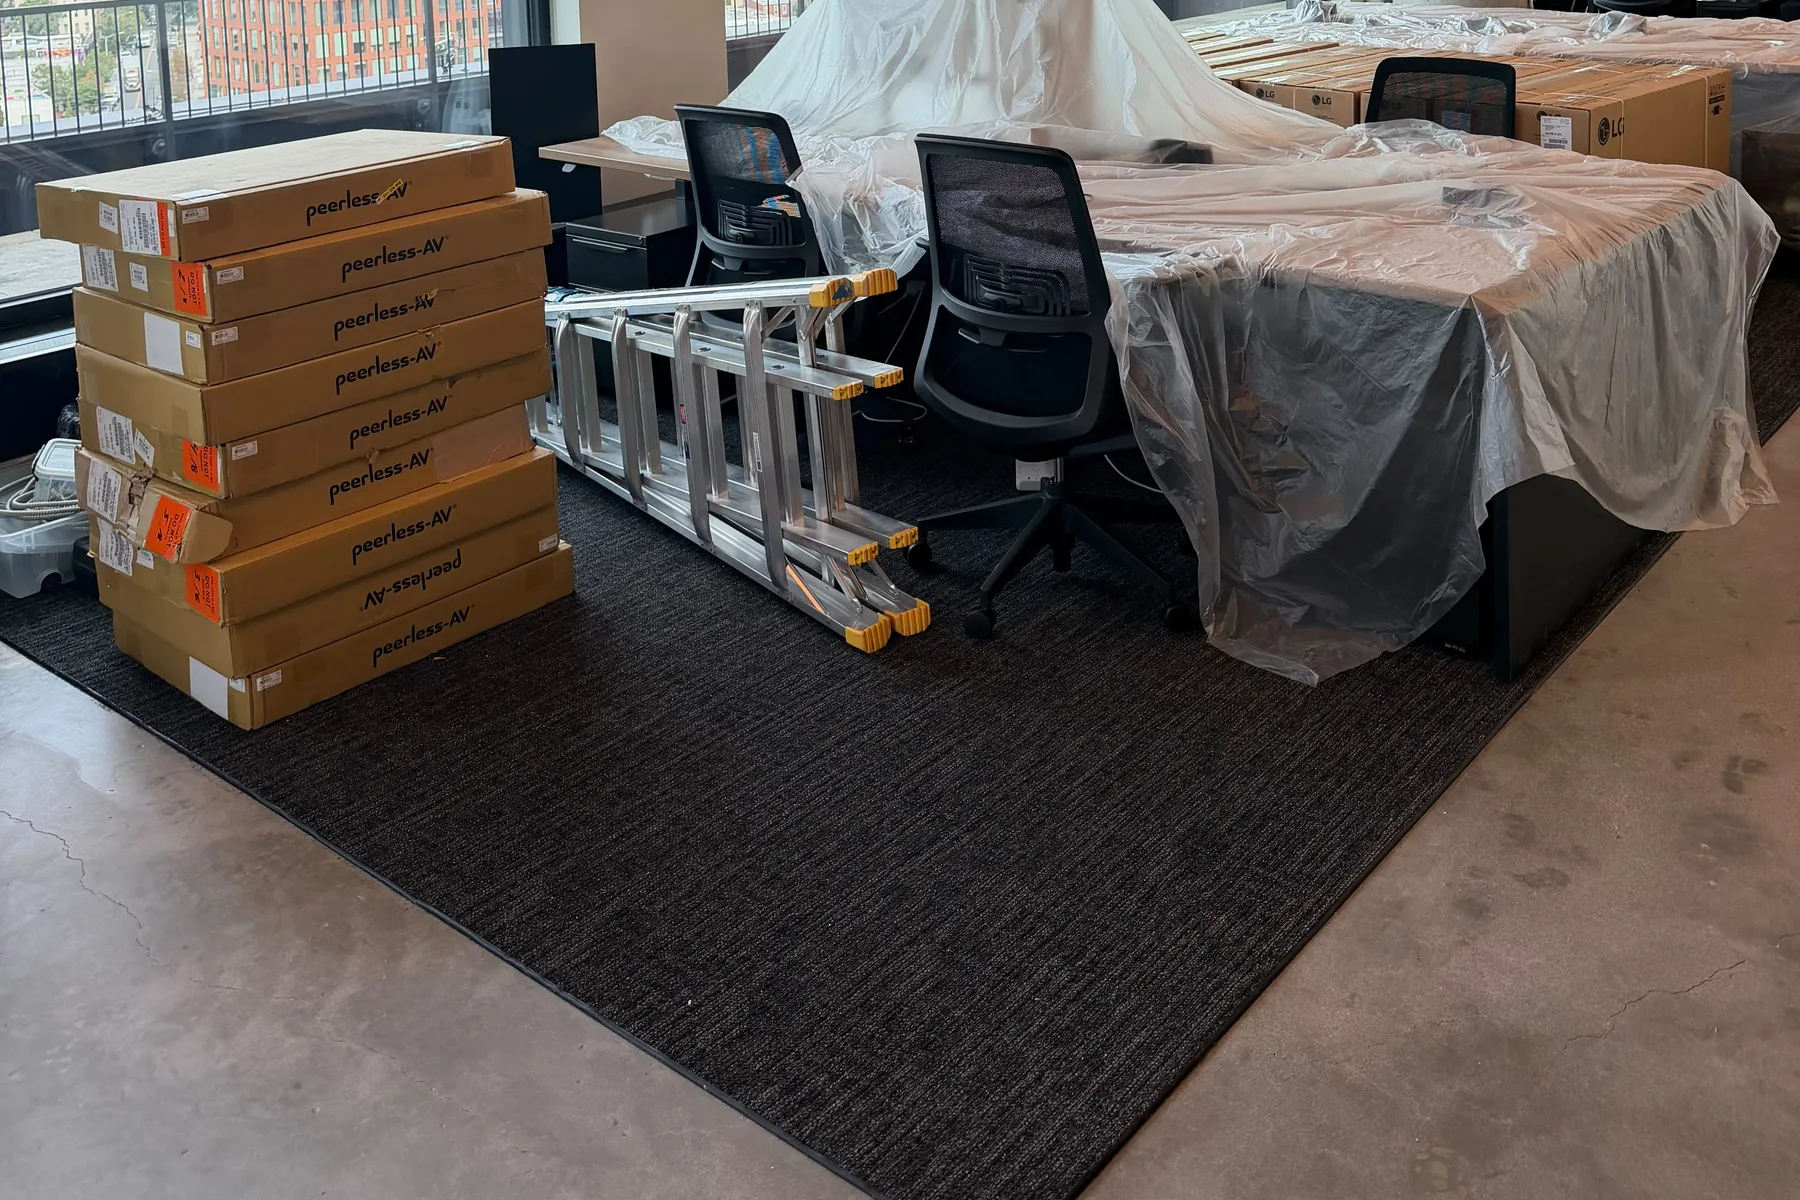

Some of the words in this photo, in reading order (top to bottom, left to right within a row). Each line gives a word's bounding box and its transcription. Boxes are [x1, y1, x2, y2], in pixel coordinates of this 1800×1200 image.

[1265, 90, 1275, 99] LG
[1322, 97, 1332, 105] LG
[341, 236, 445, 283] peerless-AV
[335, 343, 437, 395] peerless-AV
[349, 395, 448, 450] peerless-AV
[329, 448, 430, 506] peerless-AV
[351, 505, 453, 566] peerless-AV
[364, 548, 462, 611] peerless-AV
[372, 605, 471, 668] peerless-AV
